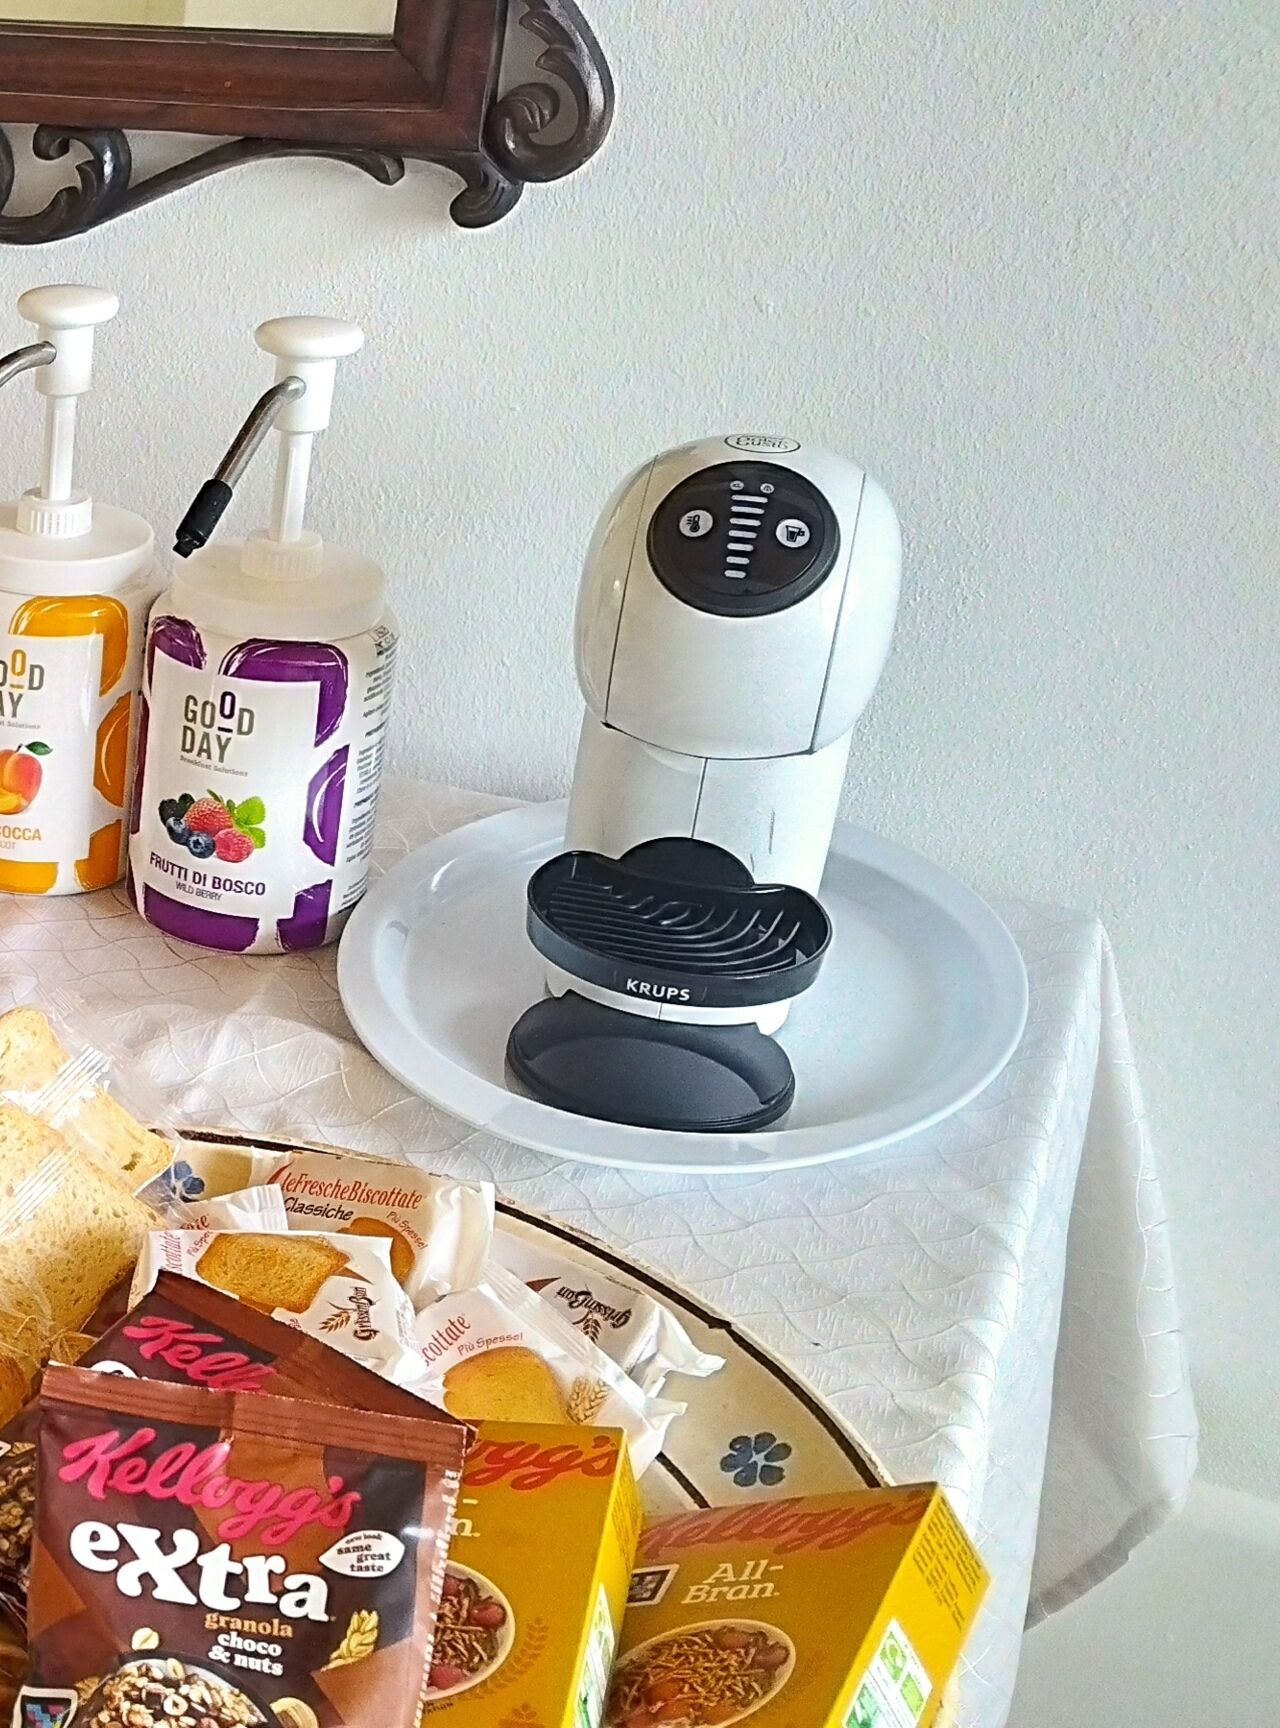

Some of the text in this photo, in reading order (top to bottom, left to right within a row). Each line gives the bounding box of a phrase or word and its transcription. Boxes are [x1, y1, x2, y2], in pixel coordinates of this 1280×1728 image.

[183, 690, 255, 736] GOOD
[180, 725, 232, 764] DAY
[149, 851, 266, 896] FRUTTI DI BOSCO
[175, 881, 223, 902] WILD BERRY
[626, 978, 691, 1001] KRUPS
[283, 1196, 355, 1222] Classiche
[58, 1427, 363, 1546] Kellogg's
[336, 1543, 372, 1556] same
[356, 1552, 392, 1564] great
[349, 1563, 384, 1573] taste
[703, 1559, 784, 1584] All-
[204, 1613, 294, 1640] granola
[216, 1632, 283, 1657] choco
[207, 1645, 284, 1677] & nuts
